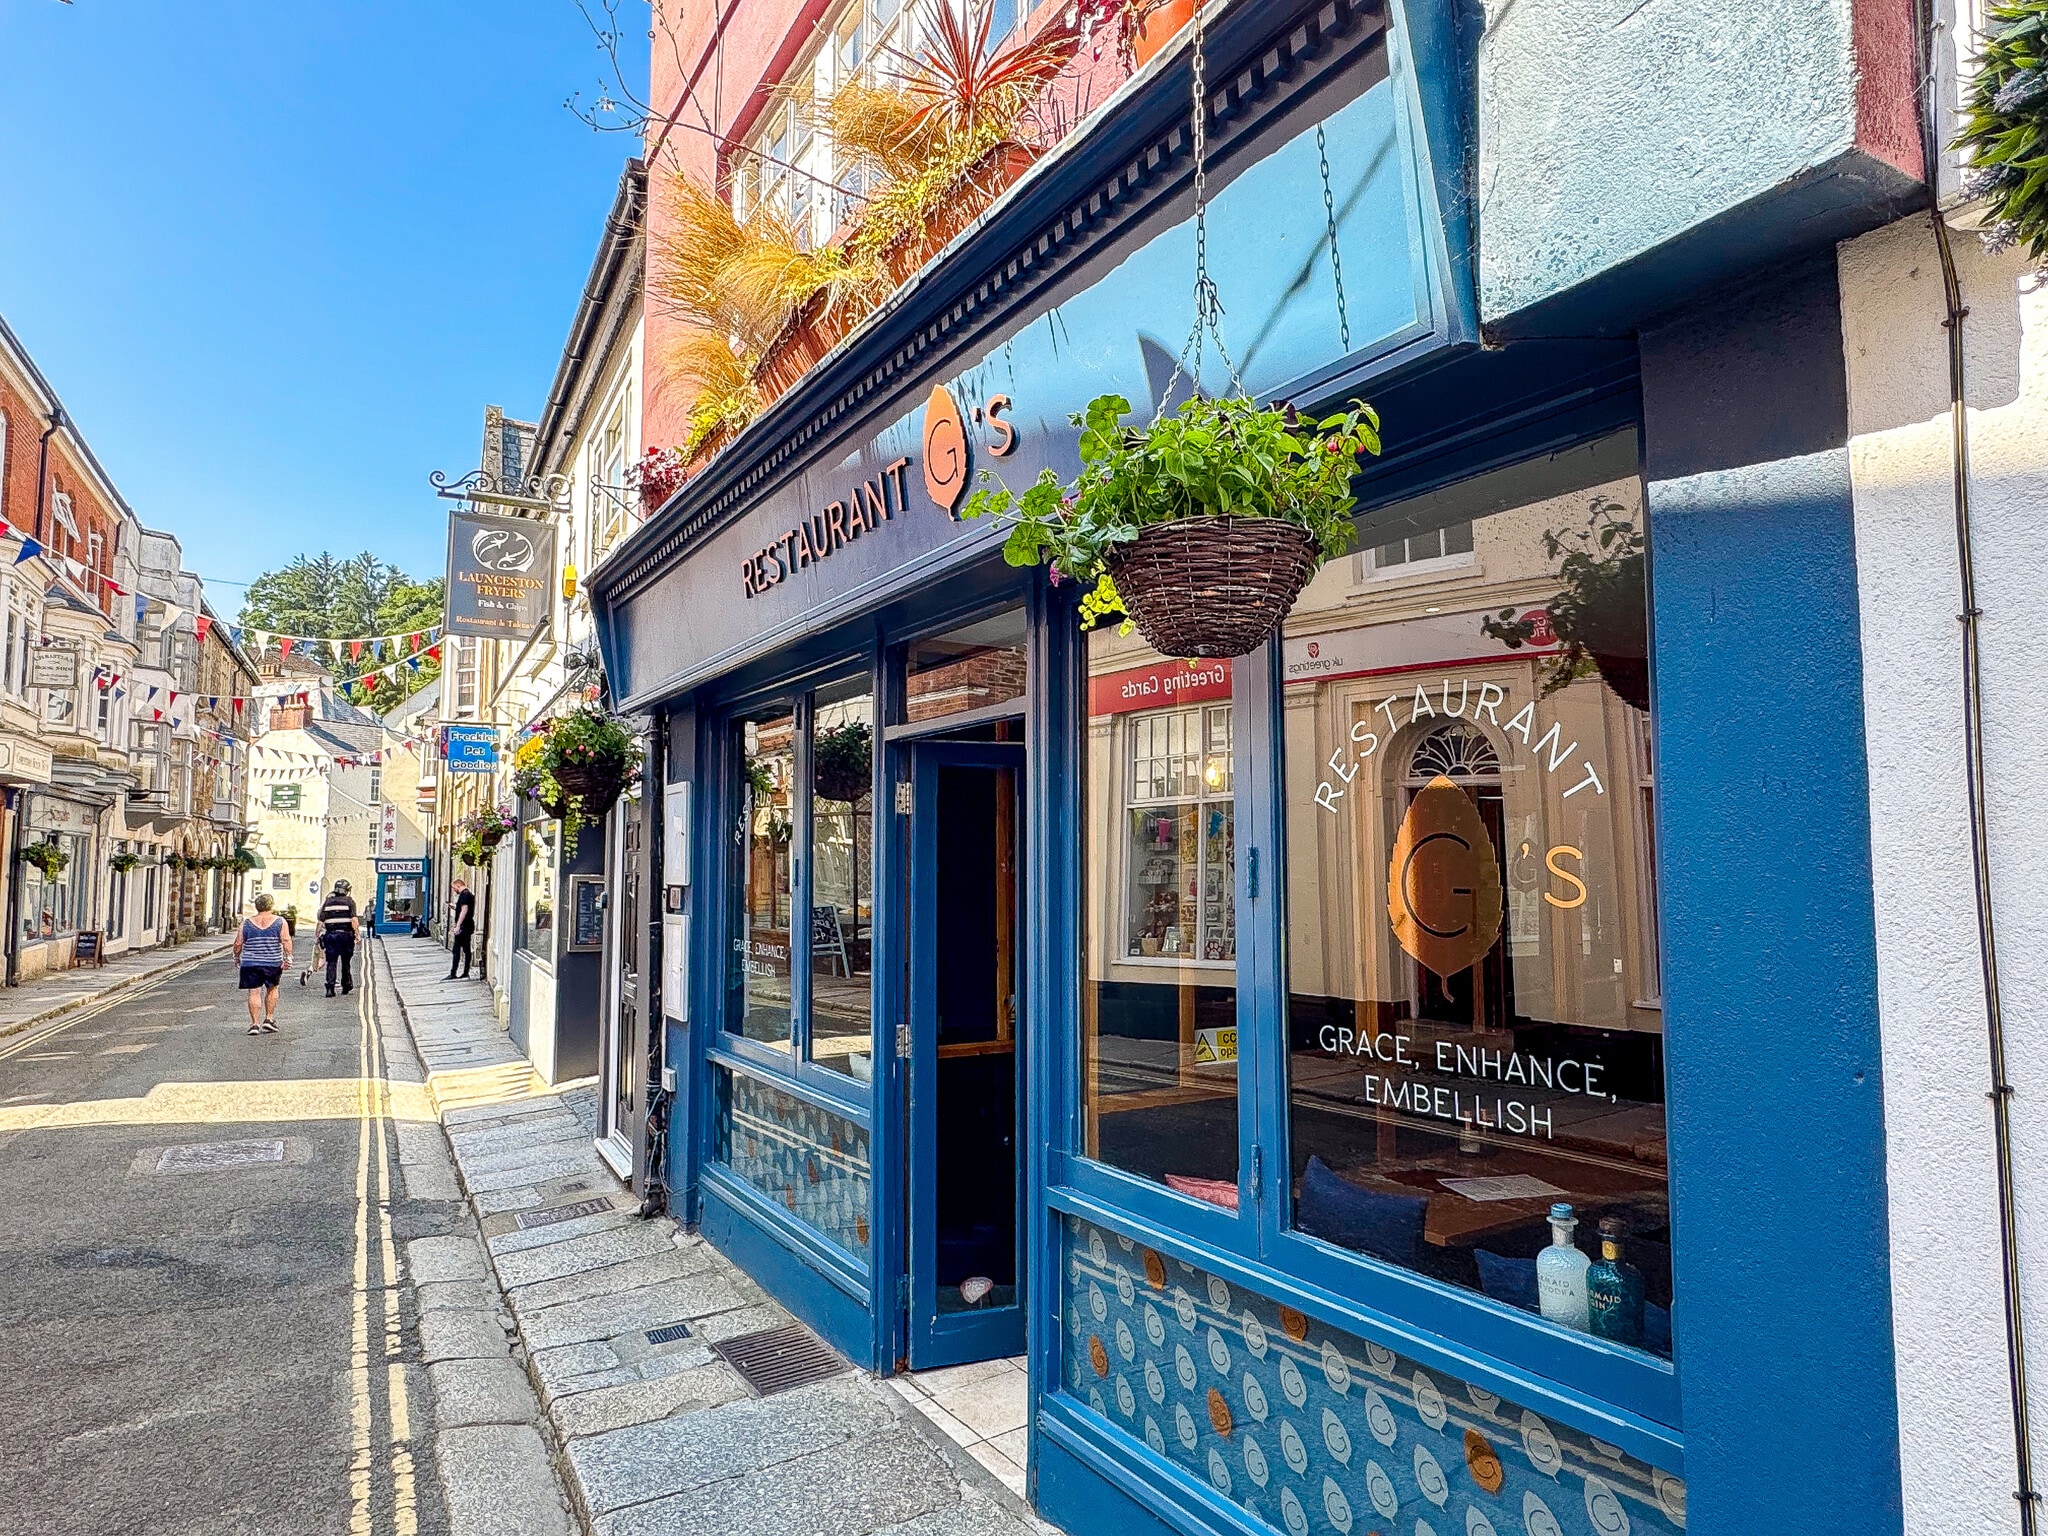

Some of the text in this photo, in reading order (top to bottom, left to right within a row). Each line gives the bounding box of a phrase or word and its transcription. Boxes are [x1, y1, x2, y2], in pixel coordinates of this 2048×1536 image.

[740, 457, 910, 598] RESTAURANT
[459, 571, 545, 590] LAUNCESTON
[476, 585, 526, 599] FRYERS
[478, 599, 495, 608] Fish
[506, 602, 528, 611] Chips
[456, 615, 536, 629] Restaurant & Takeaw
[451, 731, 497, 742] Freckles
[465, 746, 485, 755] Pet
[1313, 679, 1604, 814] RESTAURANT
[452, 760, 497, 769] Goodies
[380, 863, 420, 871] CHINESE
[1223, 1032, 1237, 1044] CC
[1319, 1024, 1617, 1104] GRACE, ENHANCE,
[1365, 1075, 1552, 1140] EMBELLISH
